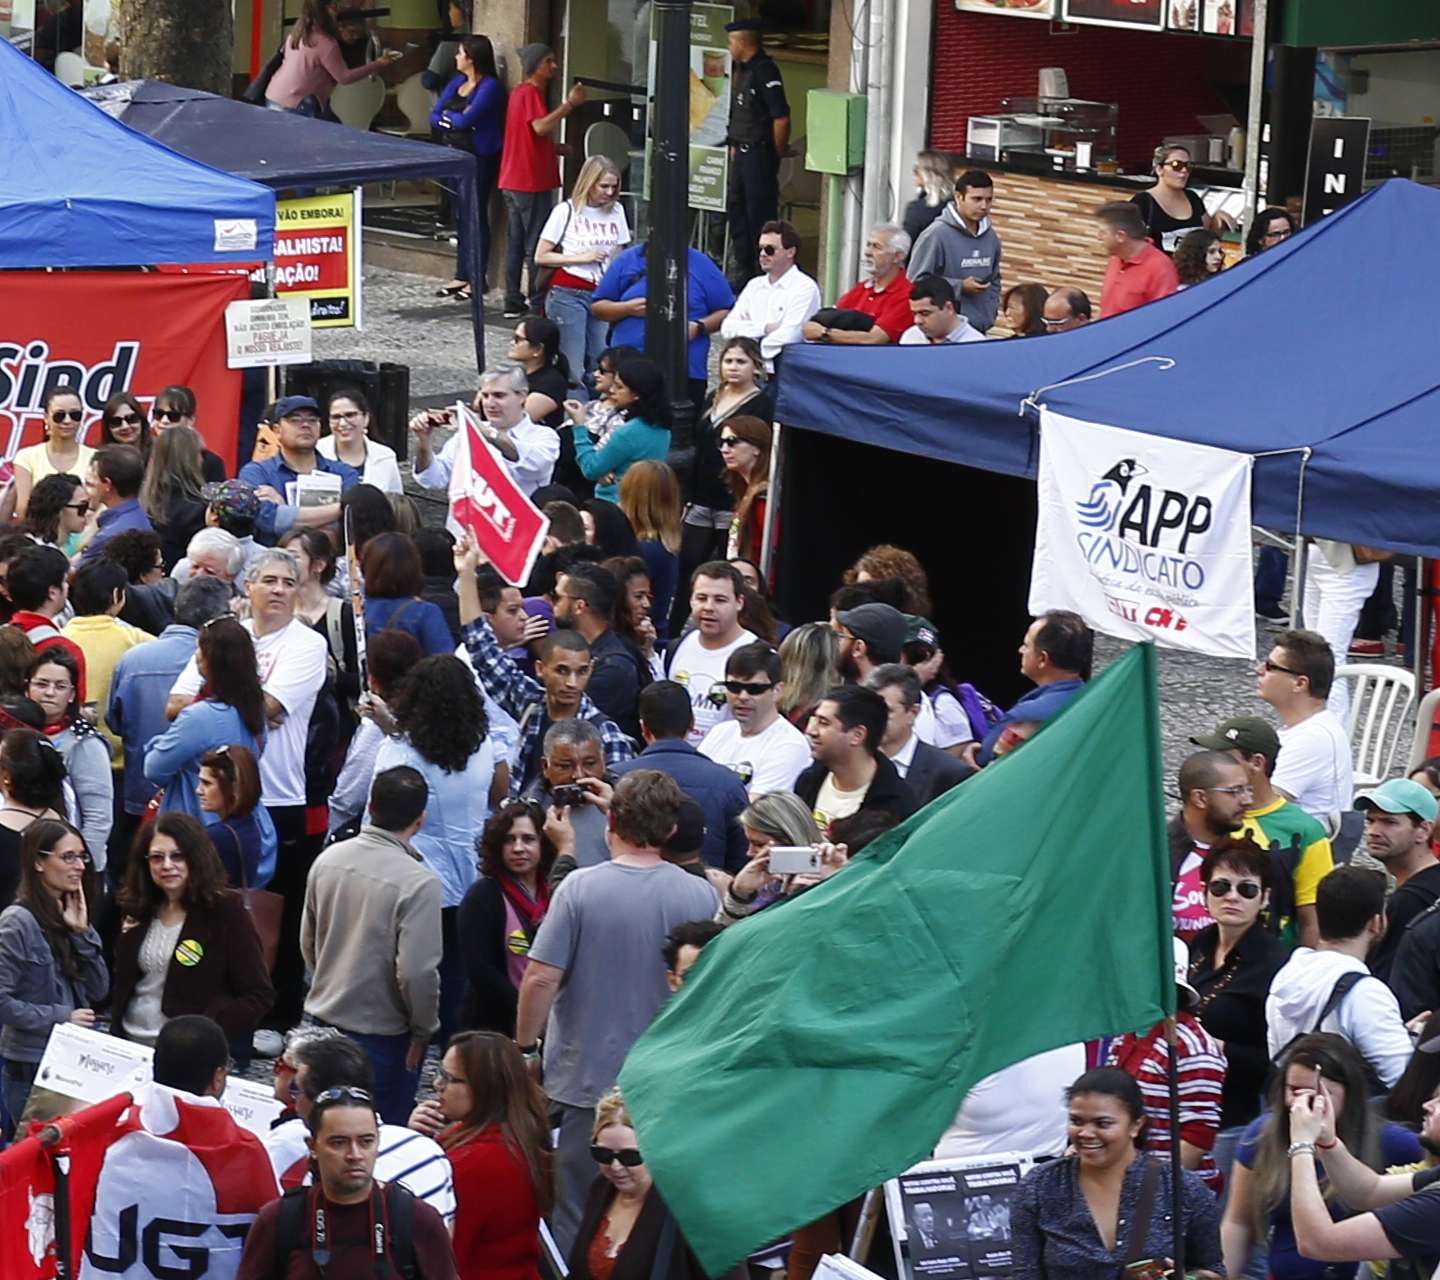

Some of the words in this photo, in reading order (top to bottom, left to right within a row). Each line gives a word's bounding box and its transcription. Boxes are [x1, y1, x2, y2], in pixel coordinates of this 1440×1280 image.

[300, 205, 345, 221] EMBORA!
[1117, 483, 1213, 555] APP
[1075, 530, 1206, 592] SINDICATO
